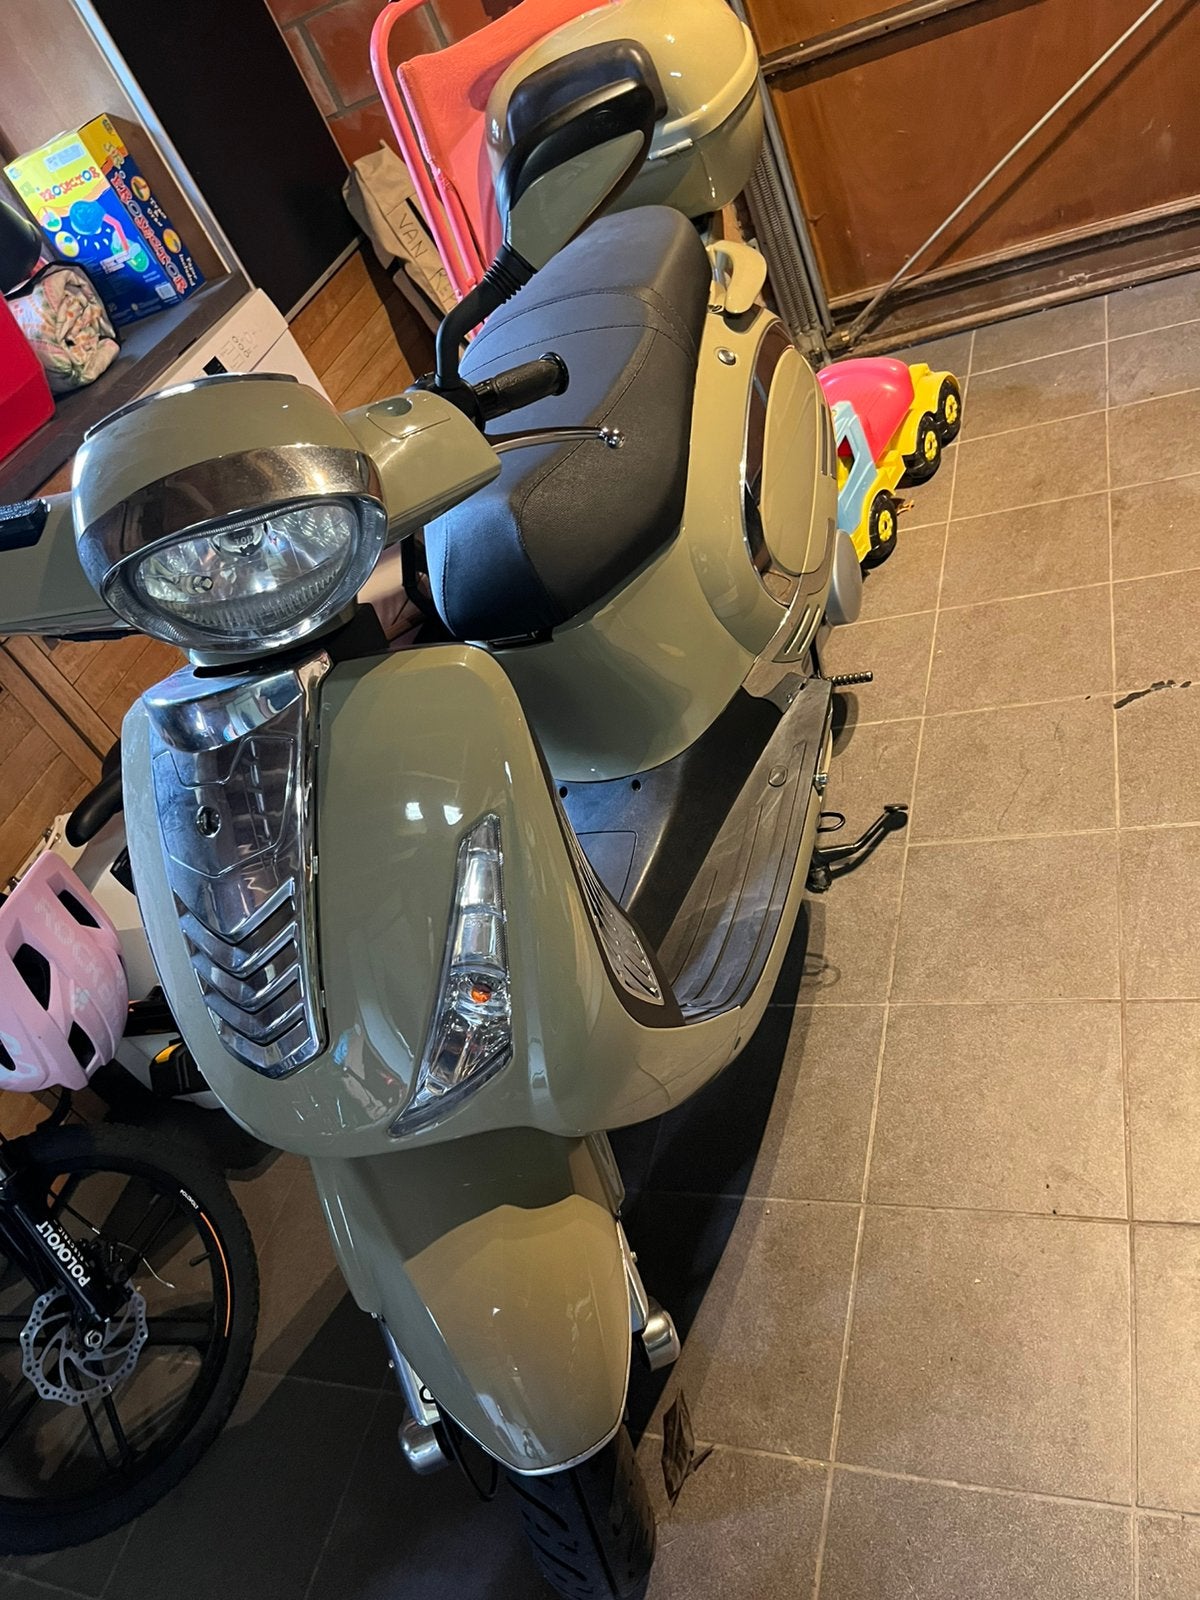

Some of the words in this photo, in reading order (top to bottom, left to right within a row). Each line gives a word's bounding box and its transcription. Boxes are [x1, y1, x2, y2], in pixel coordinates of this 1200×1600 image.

[110, 171, 188, 294] PROJECTOR
[399, 212, 428, 258] VAN
[234, 535, 253, 546] TOP
[35, 1220, 91, 1288] POLOVOLT
[58, 1226, 84, 1262] ELECTRIC
